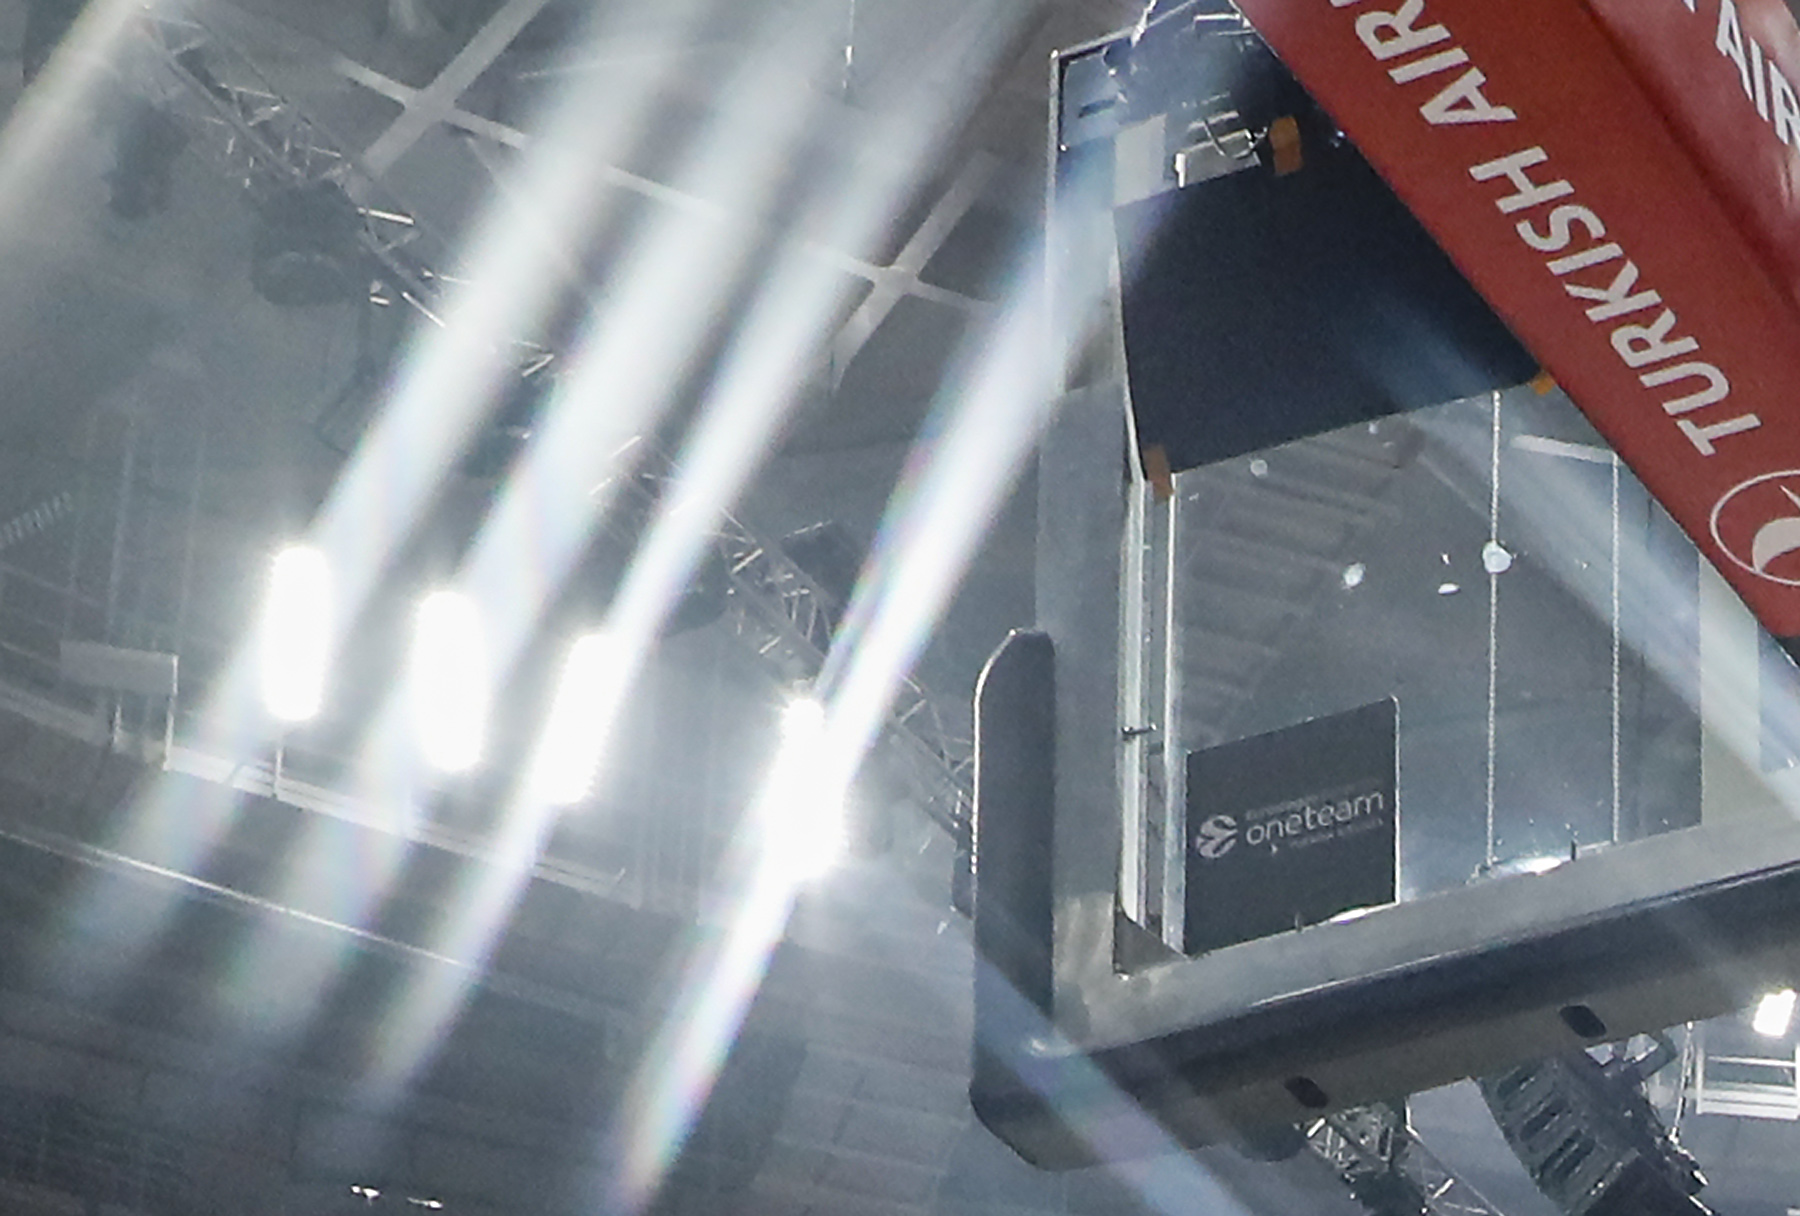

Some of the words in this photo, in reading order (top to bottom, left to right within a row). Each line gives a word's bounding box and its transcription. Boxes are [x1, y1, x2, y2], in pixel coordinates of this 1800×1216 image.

[1330, 0, 1517, 125] AIR
[1469, 146, 1761, 456] TURKISH
[1246, 791, 1384, 845] oneteam
